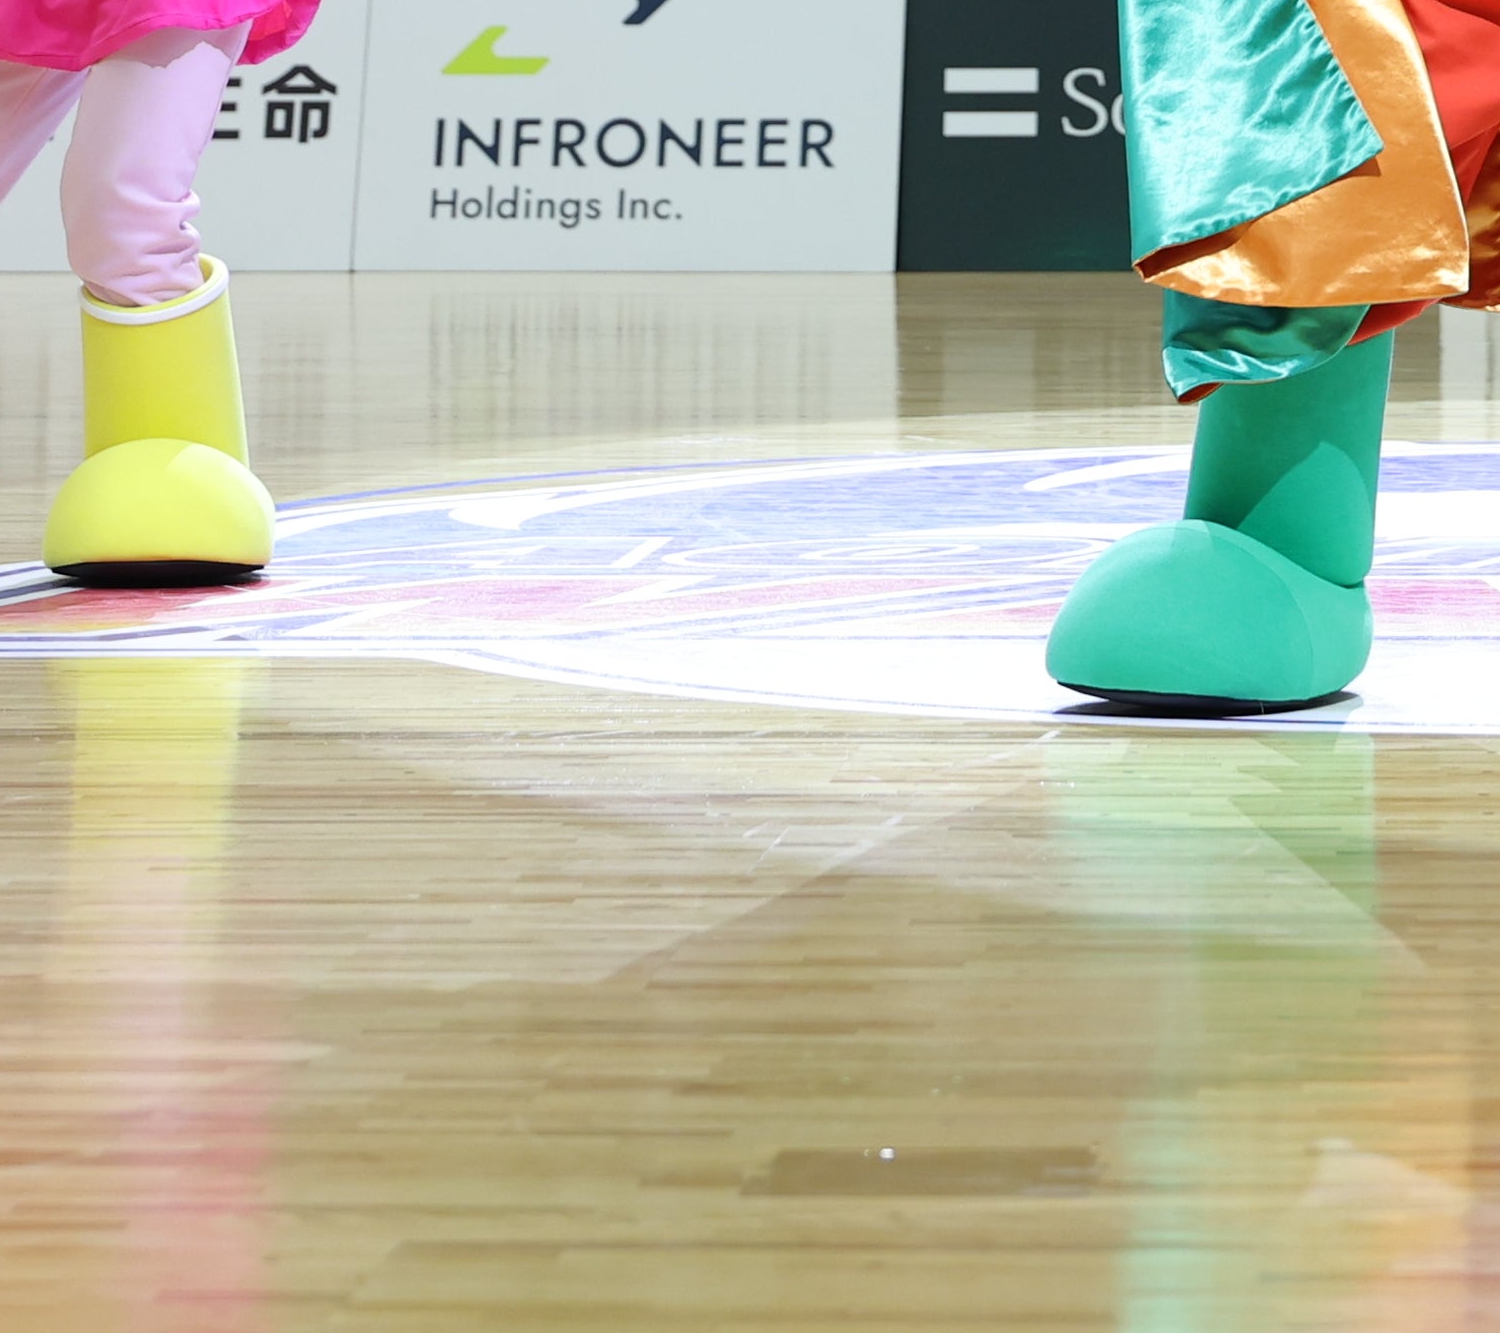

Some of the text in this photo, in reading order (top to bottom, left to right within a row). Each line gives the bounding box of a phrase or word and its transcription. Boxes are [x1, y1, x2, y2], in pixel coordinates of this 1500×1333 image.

[433, 117, 836, 168] INFRONEER
[429, 184, 683, 229] Holdings Inc.
